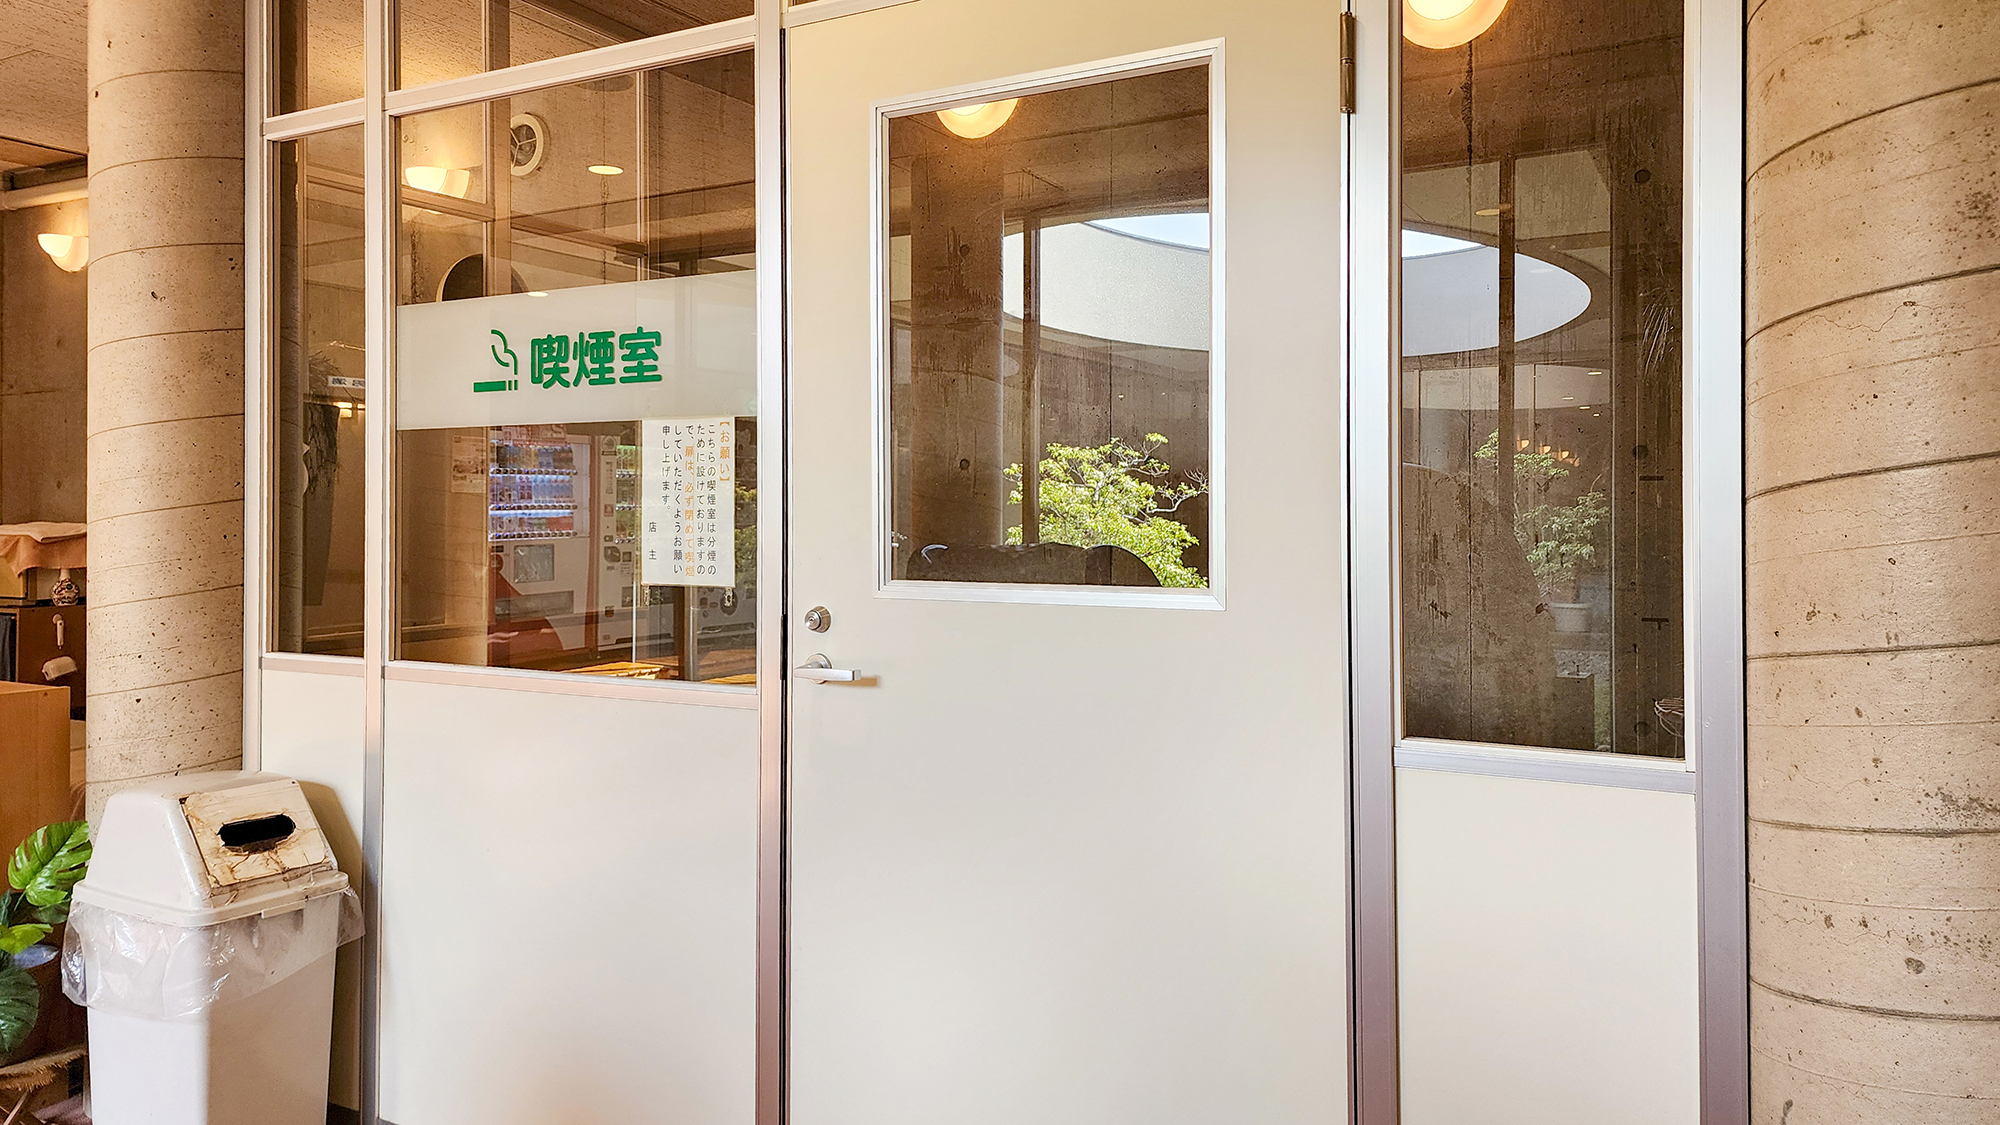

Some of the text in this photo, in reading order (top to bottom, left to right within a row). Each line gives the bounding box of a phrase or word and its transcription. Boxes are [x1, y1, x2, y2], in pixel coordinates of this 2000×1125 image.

[530, 326, 662, 389] 喫煙室
[662, 424, 671, 510] 申し上げます。
[673, 424, 683, 574] していただくようお願い
[696, 424, 706, 575] ために設けておりますの
[707, 424, 717, 576] こちらの喫煙室は分煙の
